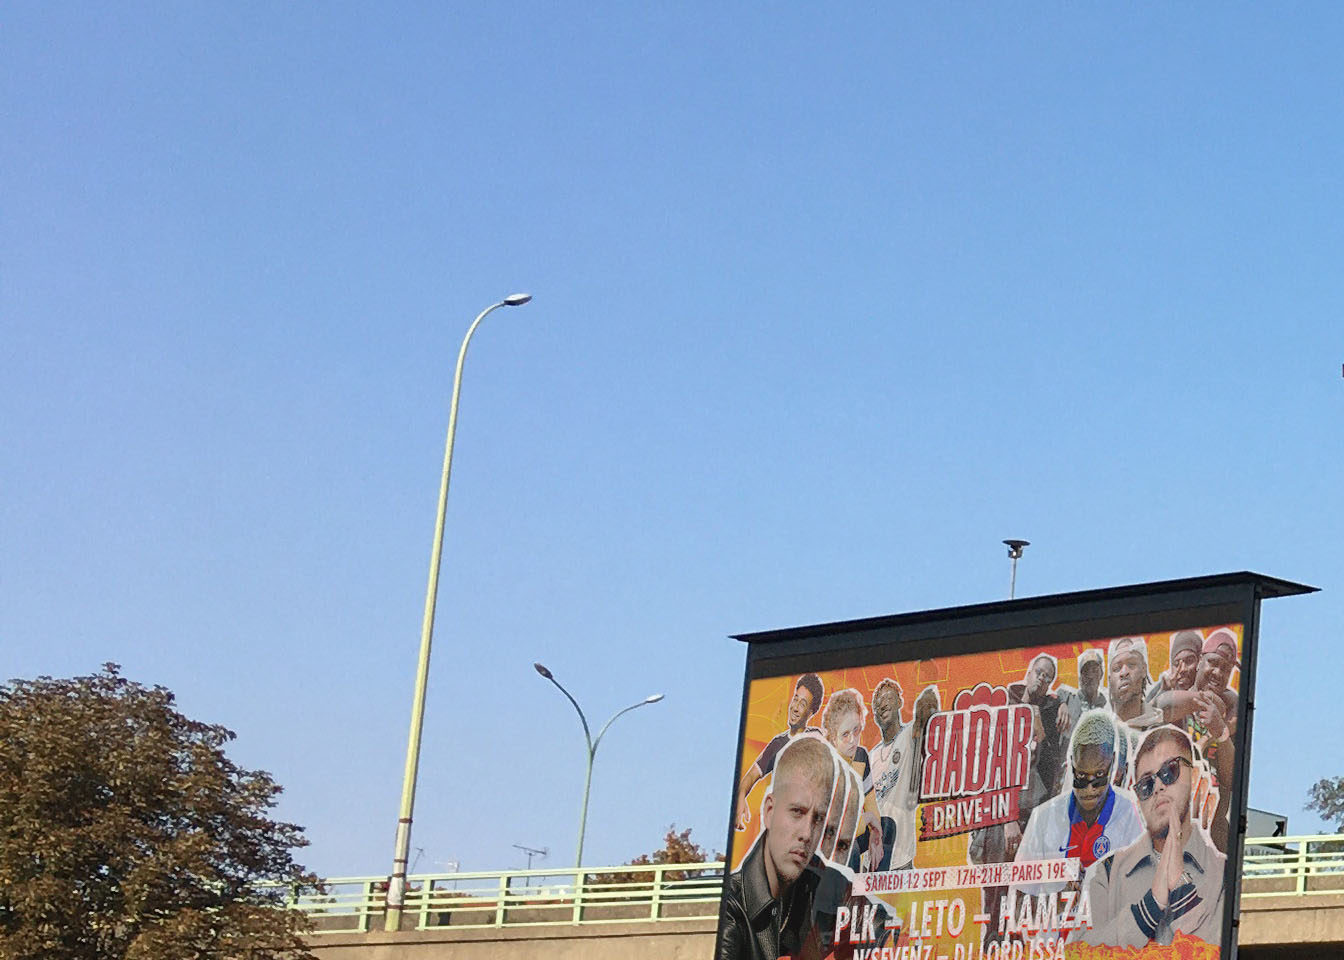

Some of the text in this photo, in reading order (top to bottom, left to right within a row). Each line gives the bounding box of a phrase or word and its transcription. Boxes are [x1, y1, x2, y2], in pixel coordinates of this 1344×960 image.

[933, 791, 1010, 831] DRIVE-IN
[865, 862, 1066, 892] SAMEDI 12 SEPT 17H-21H PARIS 19E
[834, 904, 877, 944] PLK
[909, 898, 966, 940] LETO
[998, 890, 1094, 935] HAMZA
